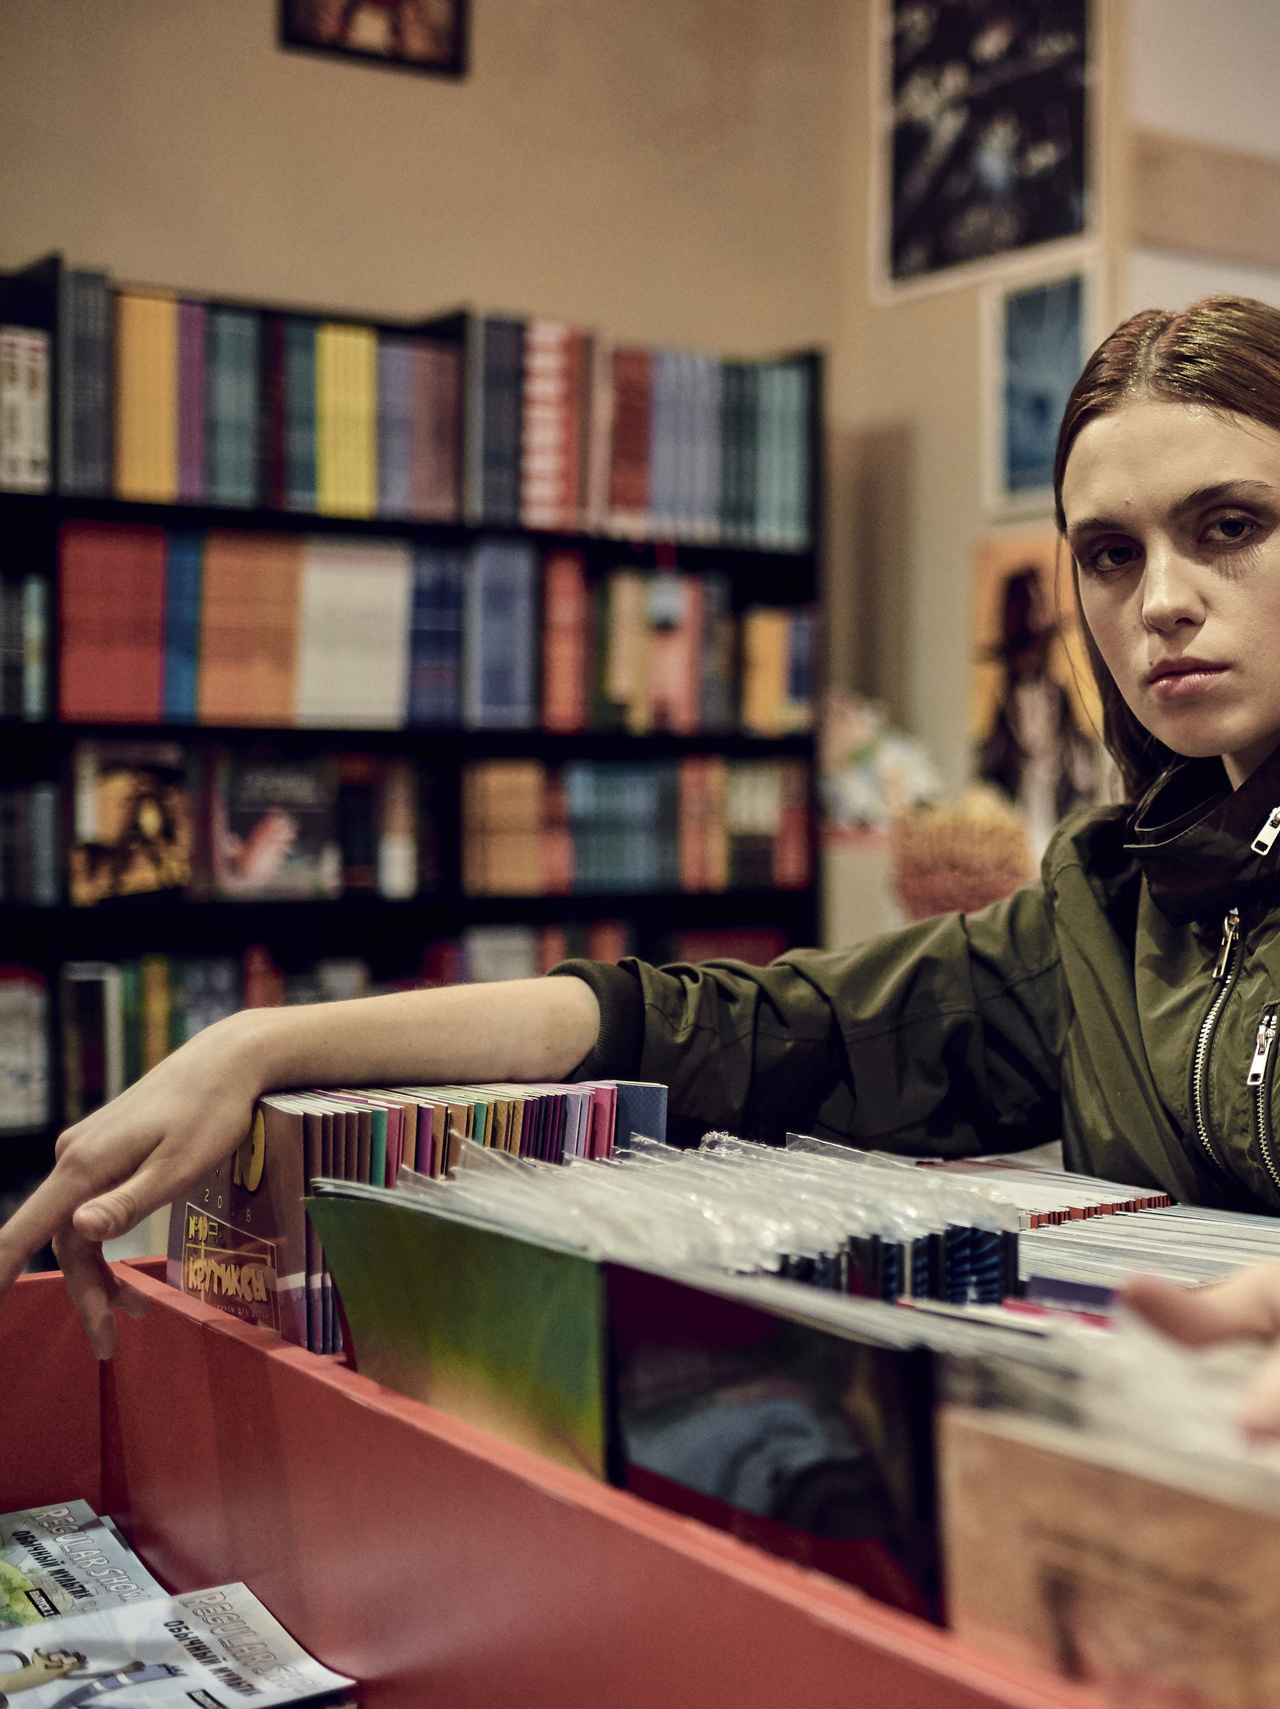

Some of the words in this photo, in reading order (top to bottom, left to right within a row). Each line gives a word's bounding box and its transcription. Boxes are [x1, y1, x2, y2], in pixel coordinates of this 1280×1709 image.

[12, 1530, 65, 1569] ОБЫЧНЫЙ
[48, 1568, 95, 1600] МУЛЬТИК
[28, 1507, 109, 1570] REGULAR
[86, 1567, 150, 1602] SHOW
[164, 1620, 227, 1667] ОБЫЧНЫЙ
[179, 1591, 277, 1667] REGULAR
